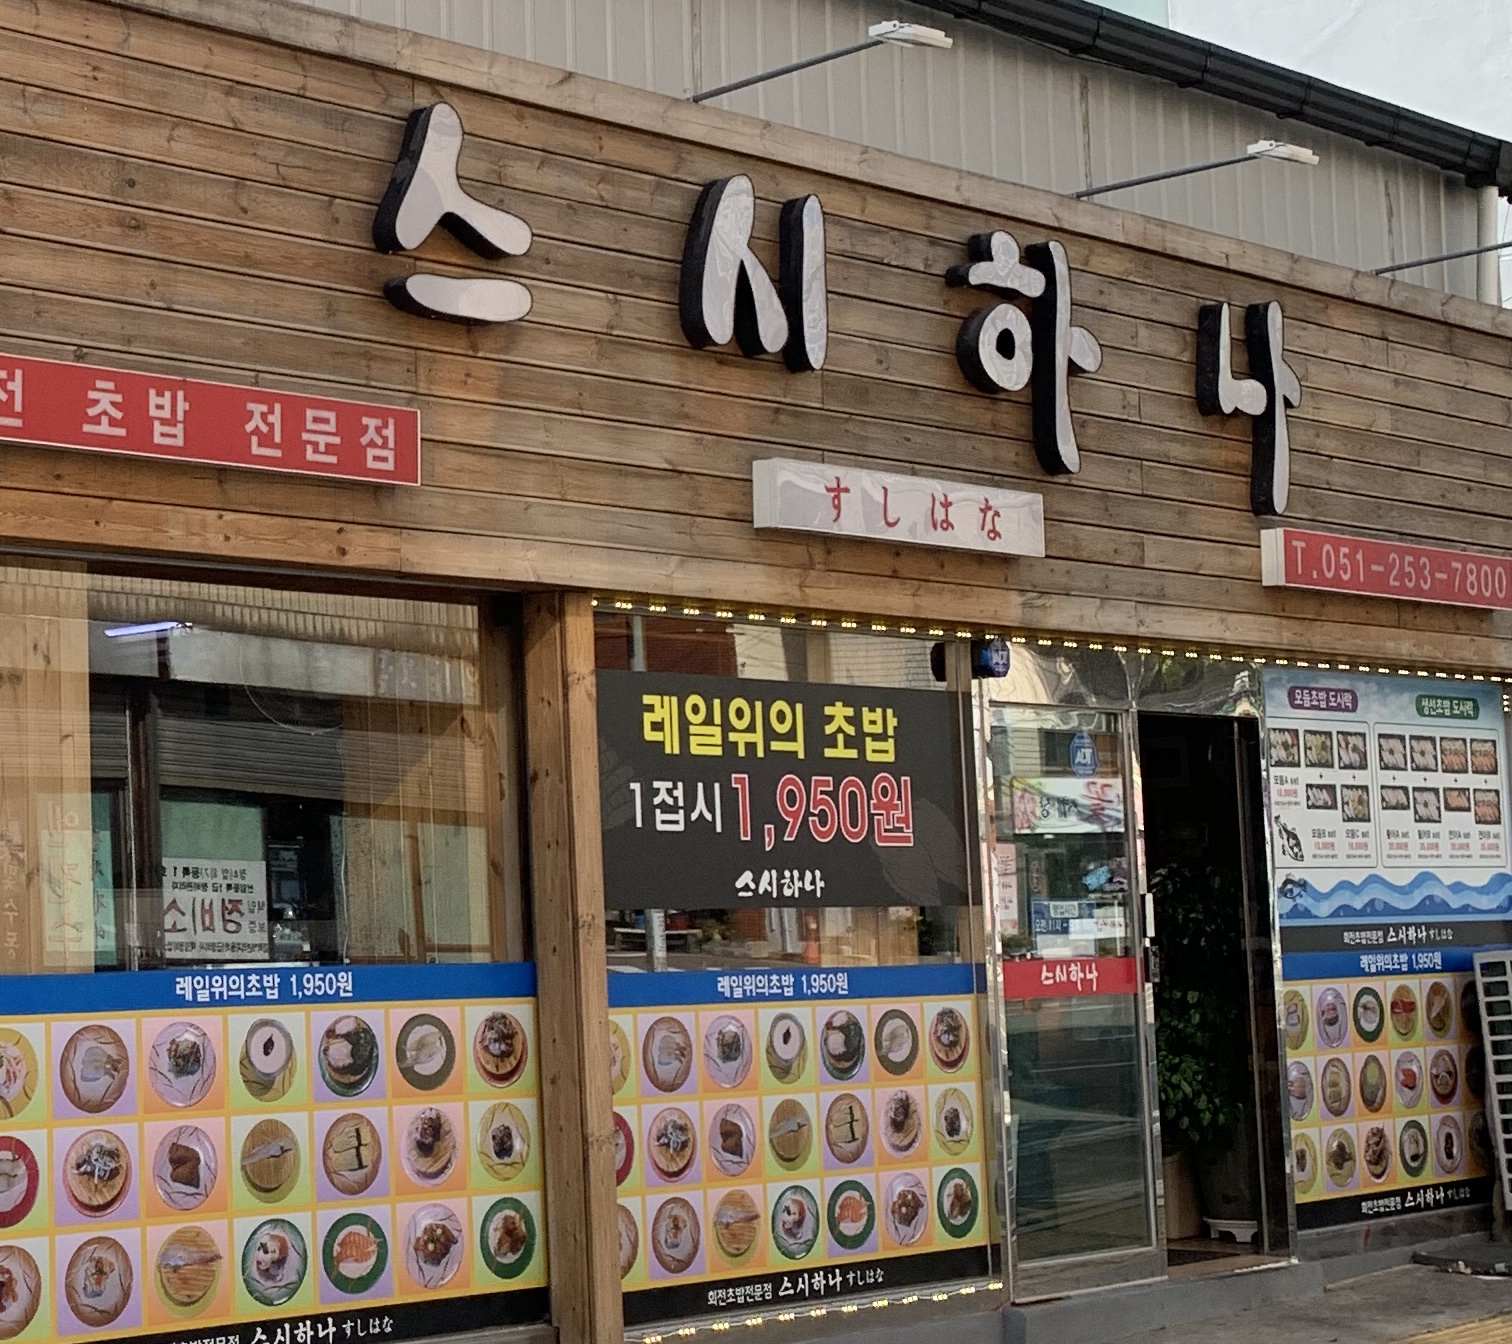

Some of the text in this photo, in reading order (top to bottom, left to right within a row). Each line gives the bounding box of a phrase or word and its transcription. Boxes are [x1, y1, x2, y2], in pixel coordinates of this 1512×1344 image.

[373, 102, 1302, 517] 스시하나
[82, 379, 190, 447] 초밥
[243, 401, 397, 472] 전문점
[824, 476, 1002, 542] すしはな
[1291, 540, 1507, 600] T.051-253-7800
[1329, 691, 1353, 710] 도시락
[642, 693, 898, 763] 레일위의 초밥
[630, 771, 915, 850] 1접시 1,950원
[734, 869, 825, 899] 스시하나
[1387, 924, 1428, 945] 스시하나
[175, 970, 354, 1002] 레일위의초밥 1,950원
[717, 970, 850, 997] 레일위의초밥 1,950원
[1041, 961, 1099, 992] 스시하나
[1404, 1185, 1445, 1209] 스시하나
[707, 1283, 773, 1307] 회전초밥전문점
[778, 1269, 843, 1299] 스시하나
[341, 1314, 394, 1340] すしはな
